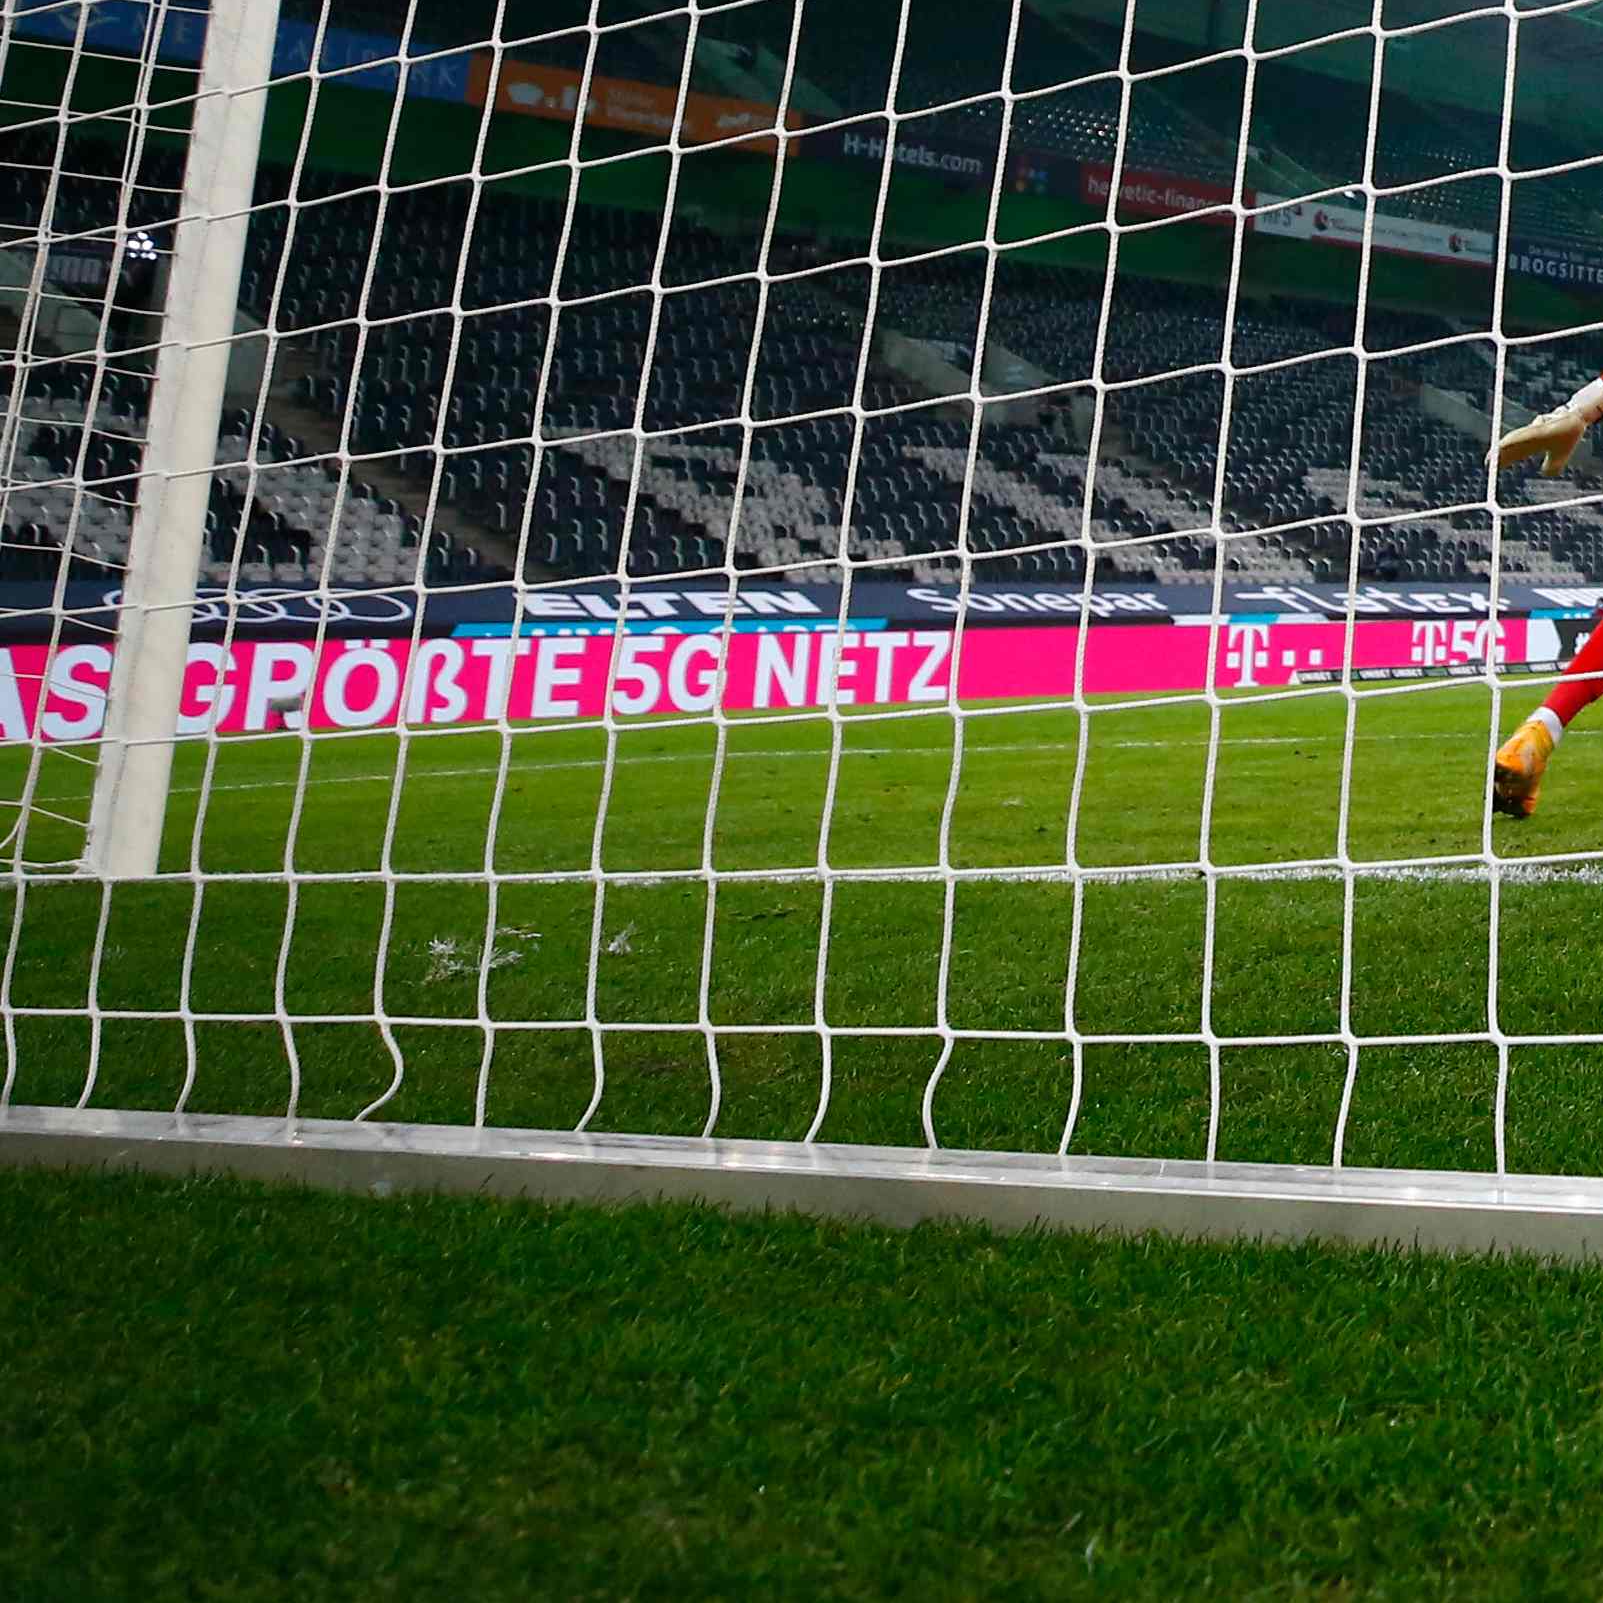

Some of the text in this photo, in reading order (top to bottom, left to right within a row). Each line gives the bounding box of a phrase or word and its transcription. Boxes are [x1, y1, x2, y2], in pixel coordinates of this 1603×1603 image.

[842, 132, 983, 174] H-Htels.com
[513, 591, 822, 619] ELTEN
[906, 587, 1168, 618] Sonepar
[177, 637, 587, 734] GRÖßTE
[612, 634, 728, 716] 5G
[752, 630, 951, 709] NETZ
